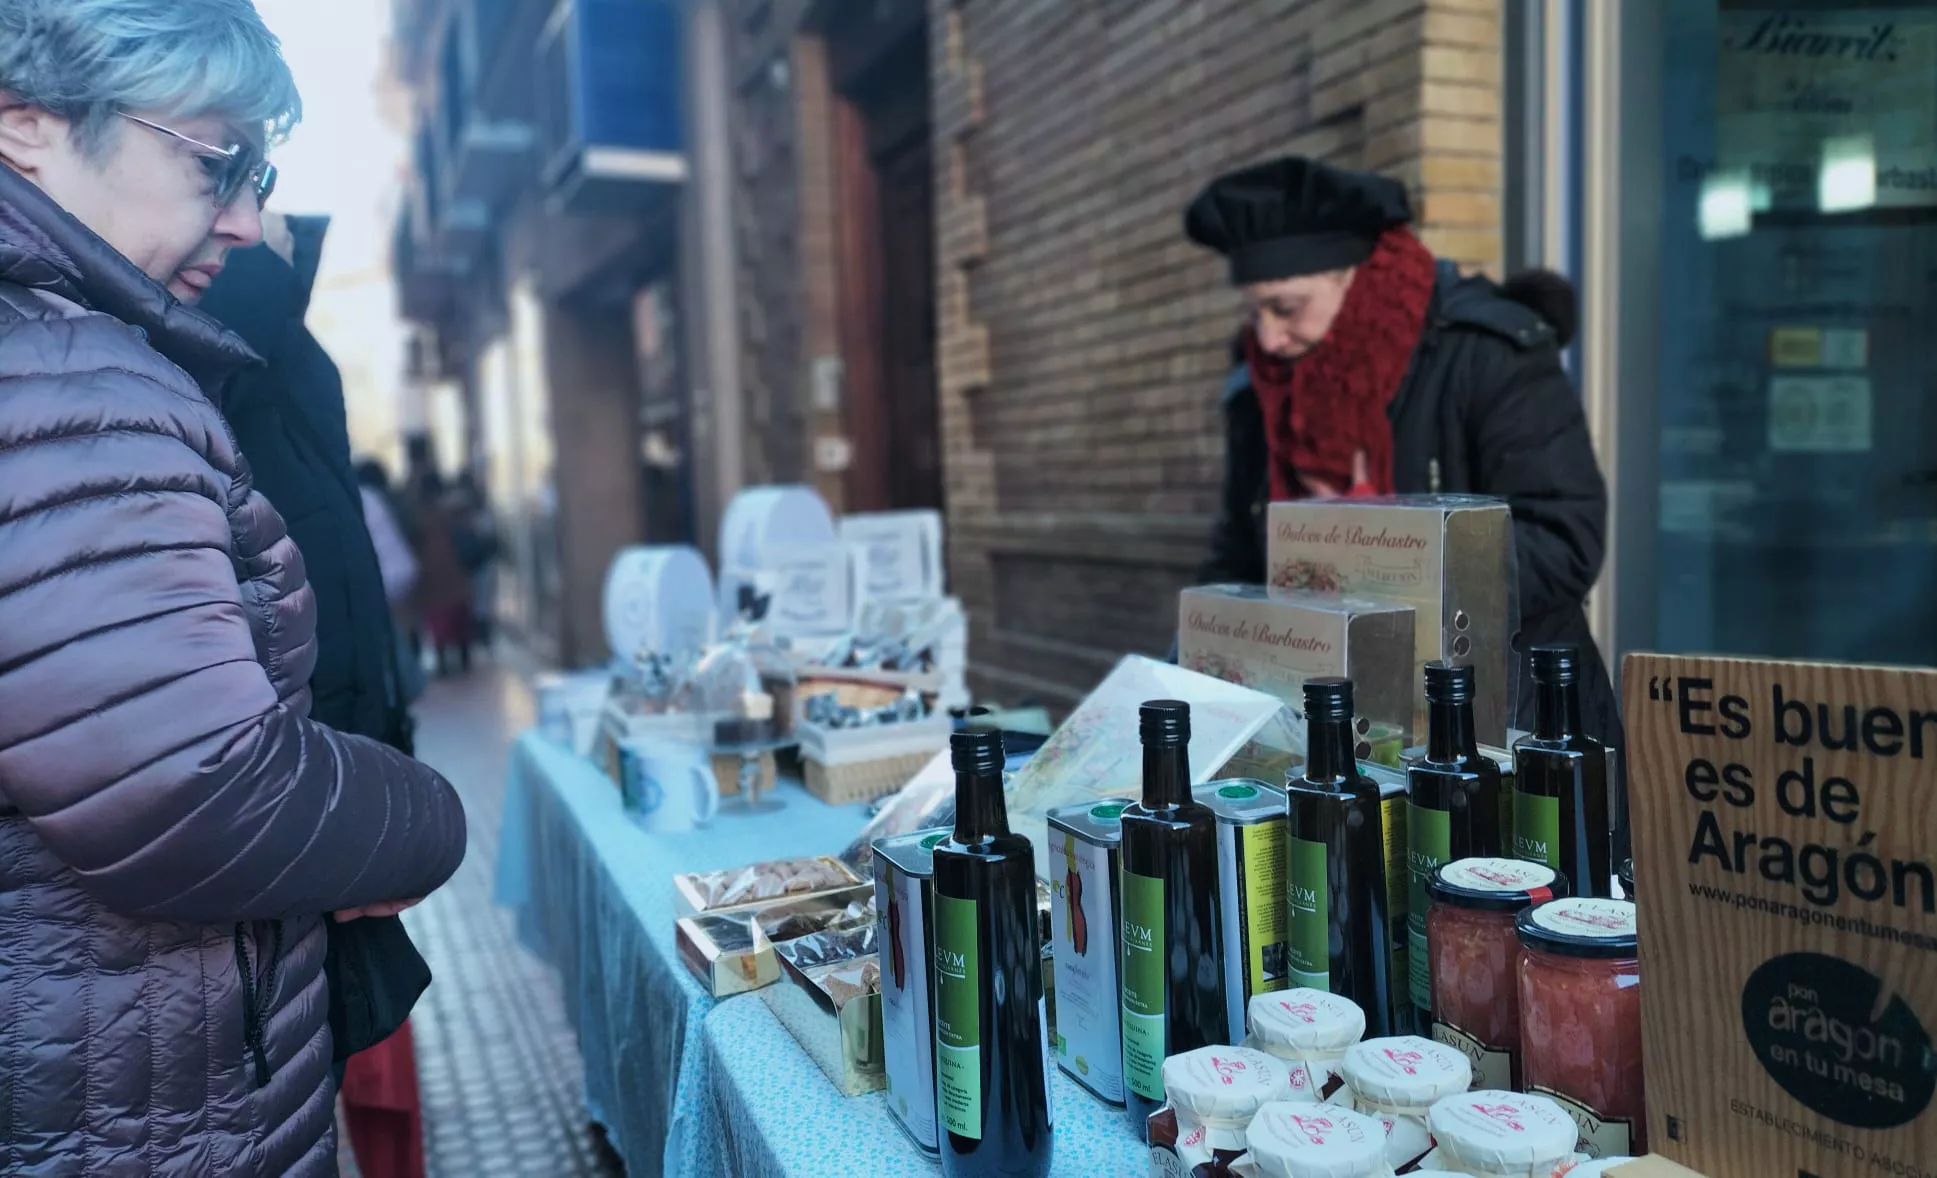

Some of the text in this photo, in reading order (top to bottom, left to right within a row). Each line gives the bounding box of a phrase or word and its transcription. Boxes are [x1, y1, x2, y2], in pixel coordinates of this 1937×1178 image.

[1277, 521, 1428, 550] Dulces de Barbastro
[1188, 611, 1332, 654] Dulces de Barbastro
[1685, 756, 1860, 824] es de
[1688, 810, 1936, 914] Aragón
[1788, 983, 1818, 1006] pon
[1770, 1044, 1905, 1102] en tu mesa
[1731, 1098, 1866, 1161] ESTABLECIMIENTO
